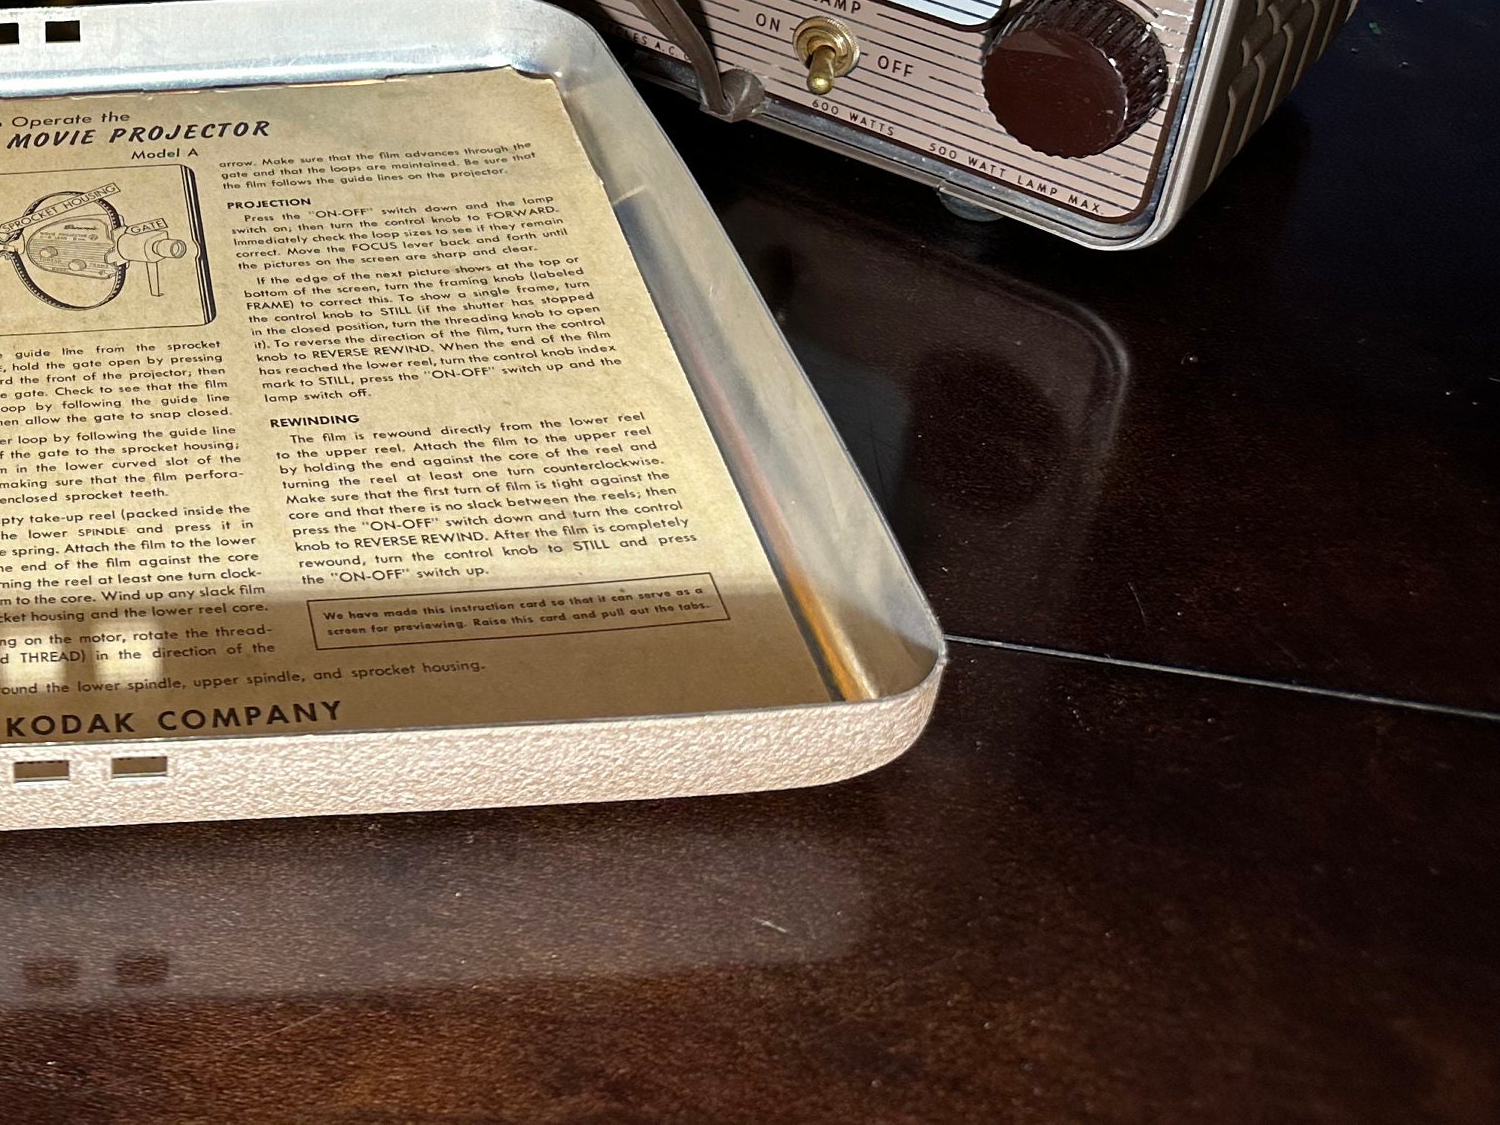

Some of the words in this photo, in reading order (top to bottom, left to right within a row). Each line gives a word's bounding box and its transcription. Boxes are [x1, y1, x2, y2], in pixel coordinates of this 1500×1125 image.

[755, 12, 782, 33] ON
[877, 55, 914, 77] OFF
[11, 114, 92, 130] Operate
[101, 111, 130, 123] the
[812, 100, 839, 115] 600
[849, 112, 895, 137] WATTS
[6, 129, 96, 150] MOVIE
[108, 120, 270, 144] PROJECTOR
[131, 147, 180, 160] Model
[187, 147, 199, 157] A
[930, 142, 957, 160] 500
[968, 156, 1005, 177] WATT
[1017, 176, 1058, 197] LAMP
[2, 205, 58, 232] SPROCKET
[64, 185, 117, 210] HOUSING
[226, 198, 311, 210] PROJECTION
[129, 220, 164, 233] GATE
[14, 348, 51, 360] guide
[61, 347, 84, 356] line
[95, 345, 125, 354] from
[136, 343, 156, 352] the
[167, 340, 220, 352] sprocket
[269, 414, 360, 428] REWINDING
[289, 434, 314, 444] The
[322, 432, 346, 442] film
[354, 432, 365, 441] is
[372, 426, 432, 439] rewound
[440, 423, 491, 435] directly
[499, 422, 533, 432] from
[539, 419, 562, 429] the
[568, 416, 608, 426] lower
[617, 411, 645, 422] reel
[45, 682, 70, 694] the
[77, 680, 121, 693] lower
[127, 677, 186, 693] spindle,
[192, 677, 239, 690] upper
[246, 670, 306, 687] spindle,
[312, 667, 343, 681] and
[350, 664, 416, 680] sprocket
[421, 660, 486, 673] housing.
[6, 712, 135, 738] KODAK
[157, 700, 341, 731] COMPANY
